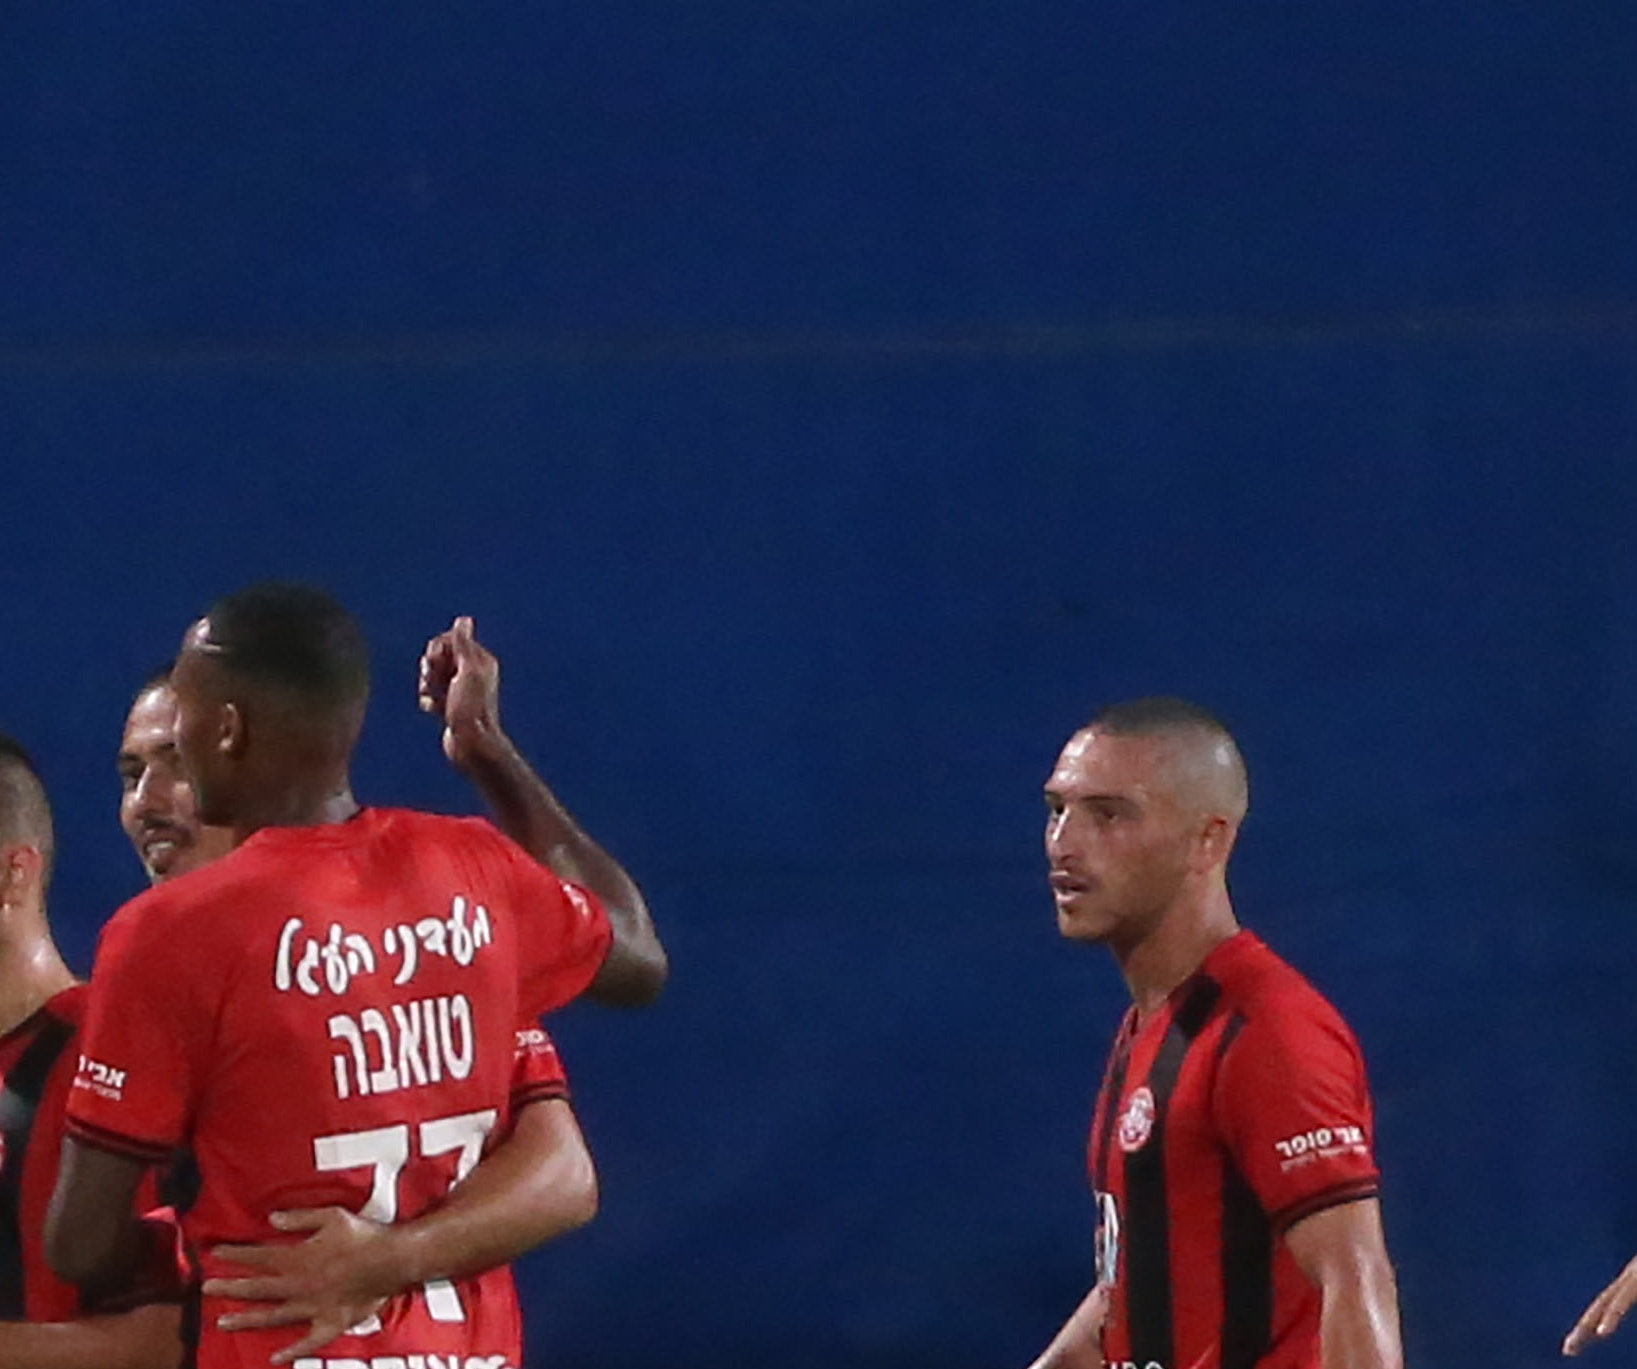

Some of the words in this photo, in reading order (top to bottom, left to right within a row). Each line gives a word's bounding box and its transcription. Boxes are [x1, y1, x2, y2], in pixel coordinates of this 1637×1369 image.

[275, 918, 376, 996] העגל
[384, 896, 492, 985] מעדני
[327, 994, 474, 1099] טואבה
